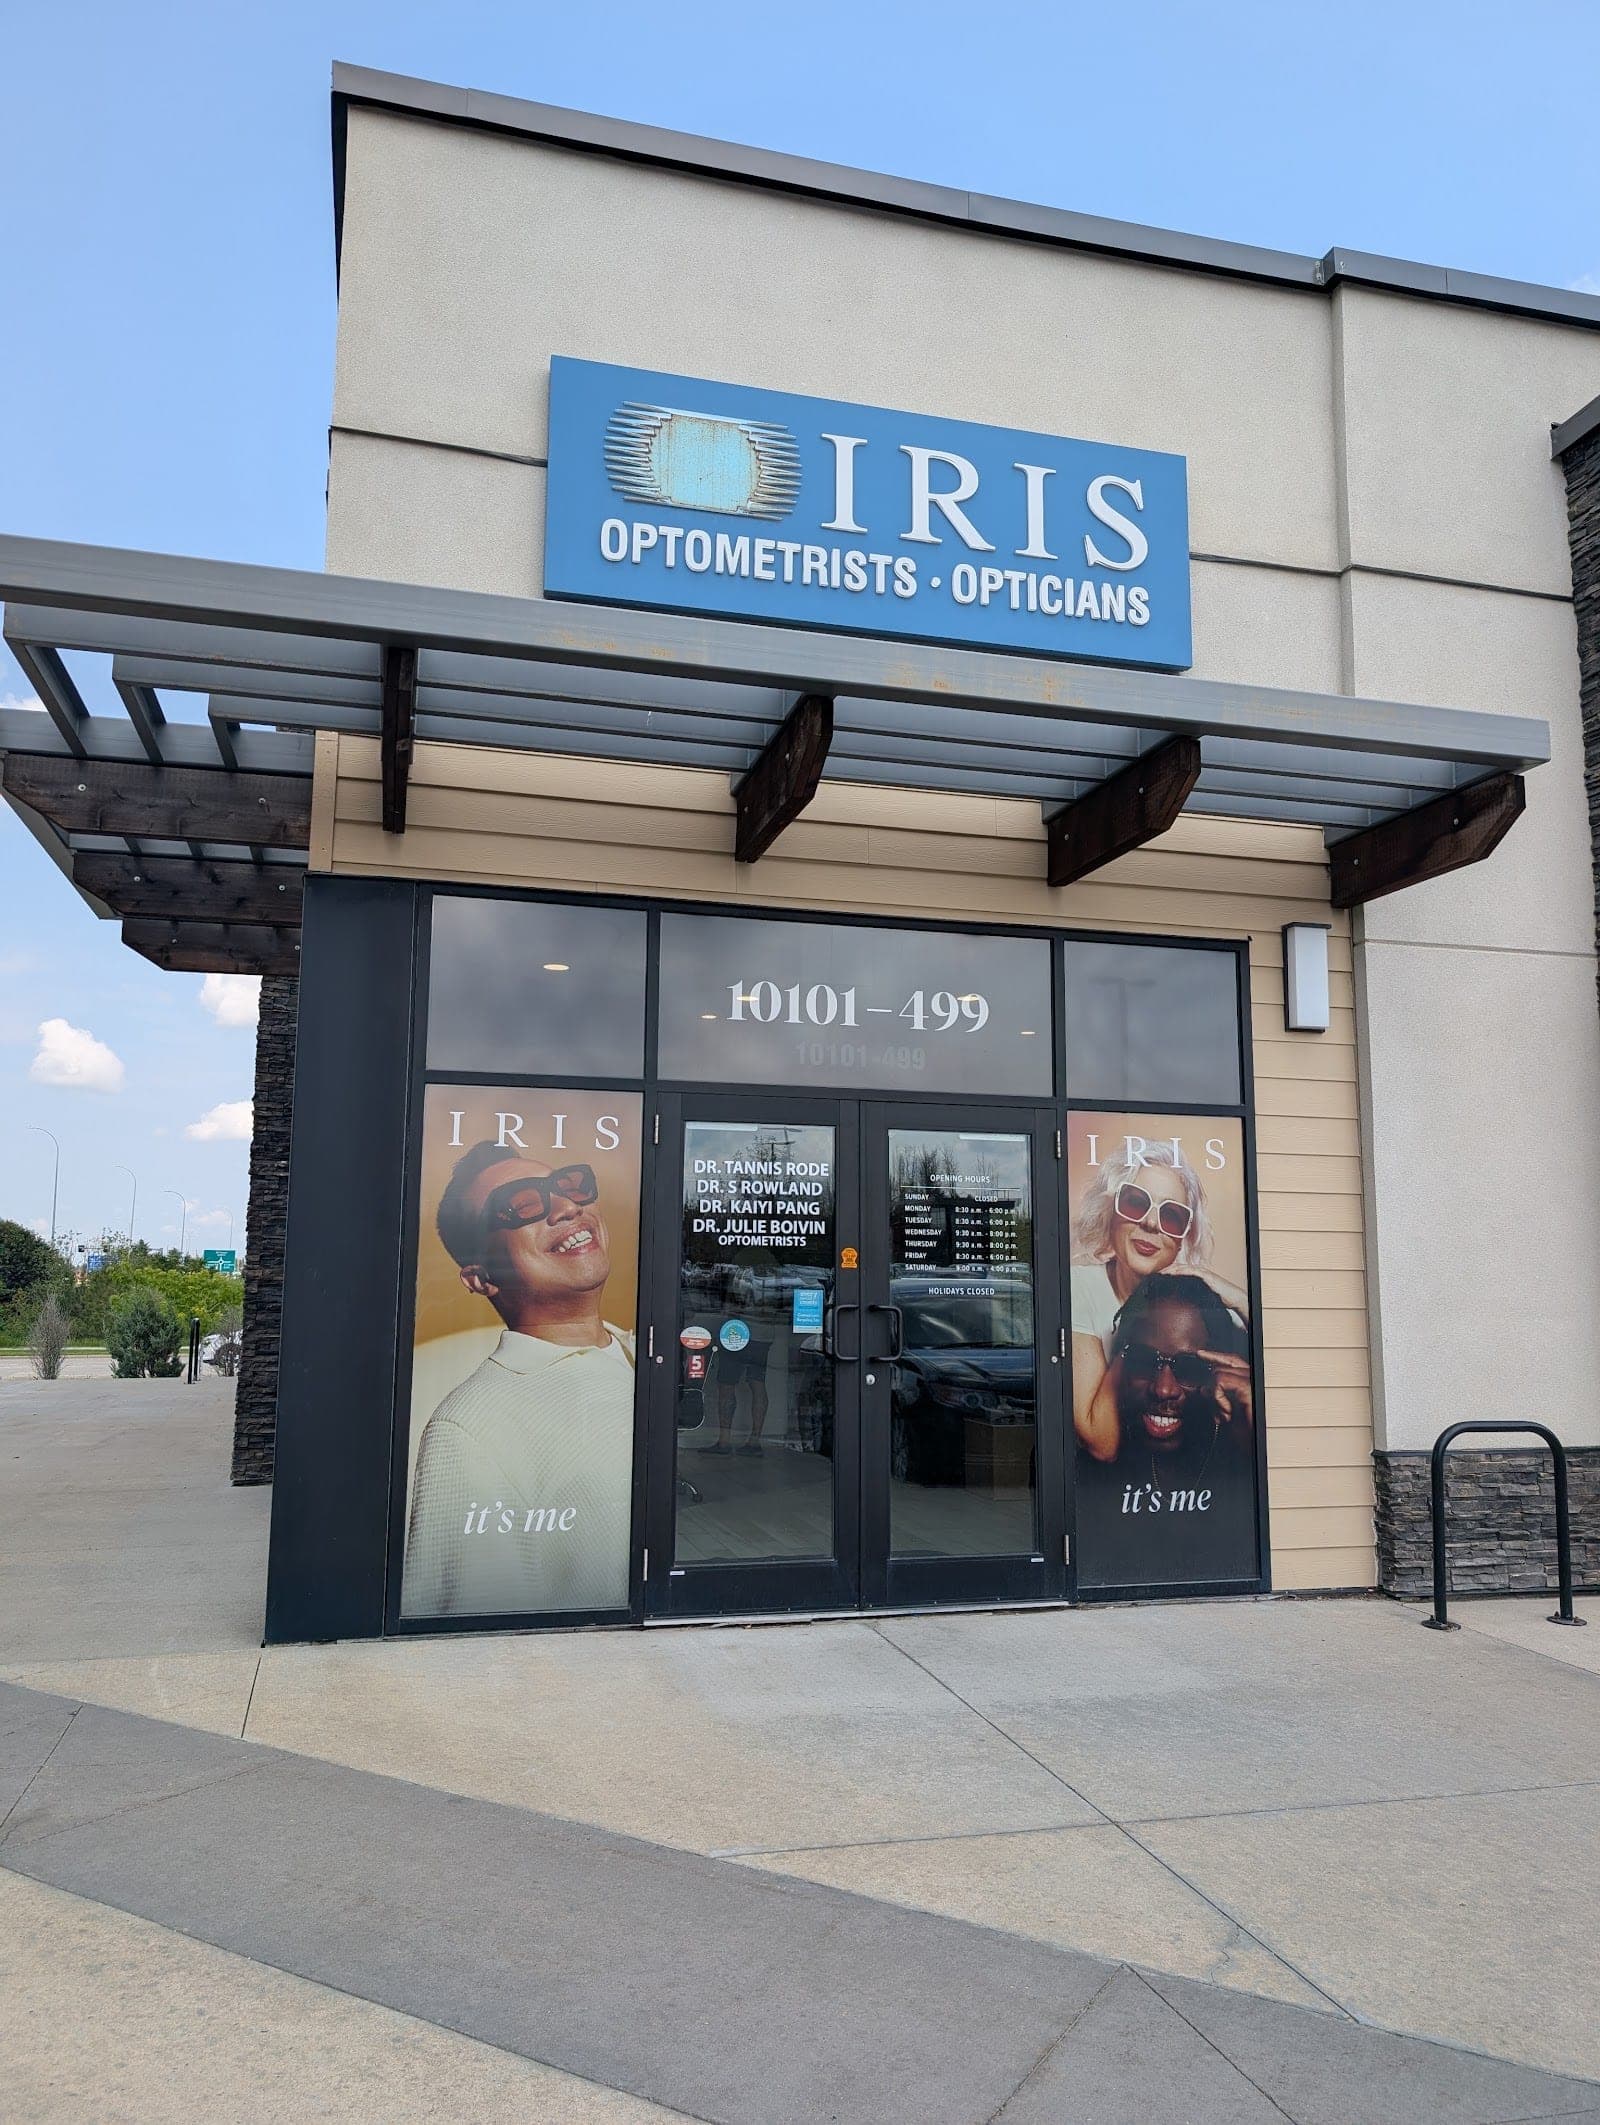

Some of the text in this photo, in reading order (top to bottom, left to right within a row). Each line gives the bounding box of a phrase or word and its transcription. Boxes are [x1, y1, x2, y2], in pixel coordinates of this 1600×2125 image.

[820, 432, 1151, 572] IRIS
[600, 517, 918, 600] OPTOMETRISTS
[951, 563, 1152, 627] OPTICIANS
[448, 1111, 620, 1151] IRIS
[1086, 1134, 1226, 1170] IRIS
[694, 1159, 829, 1177] DR. TANNIS RODE
[930, 1174, 991, 1184] OPENING HOURS
[697, 1180, 823, 1196] DR. S ROWLAND
[904, 1193, 999, 1203] SUNDAY CLOSED
[699, 1200, 820, 1216] DR. KAIYI PANG
[693, 1219, 826, 1235] DR. JULIE BOIVIN
[718, 1235, 806, 1247] OPTOMETRISTS
[928, 1287, 995, 1296] HOLIDAYS CLOSED
[691, 1355, 702, 1370] 5
[1169, 1489, 1212, 1512] me
[523, 1507, 577, 1533] me
